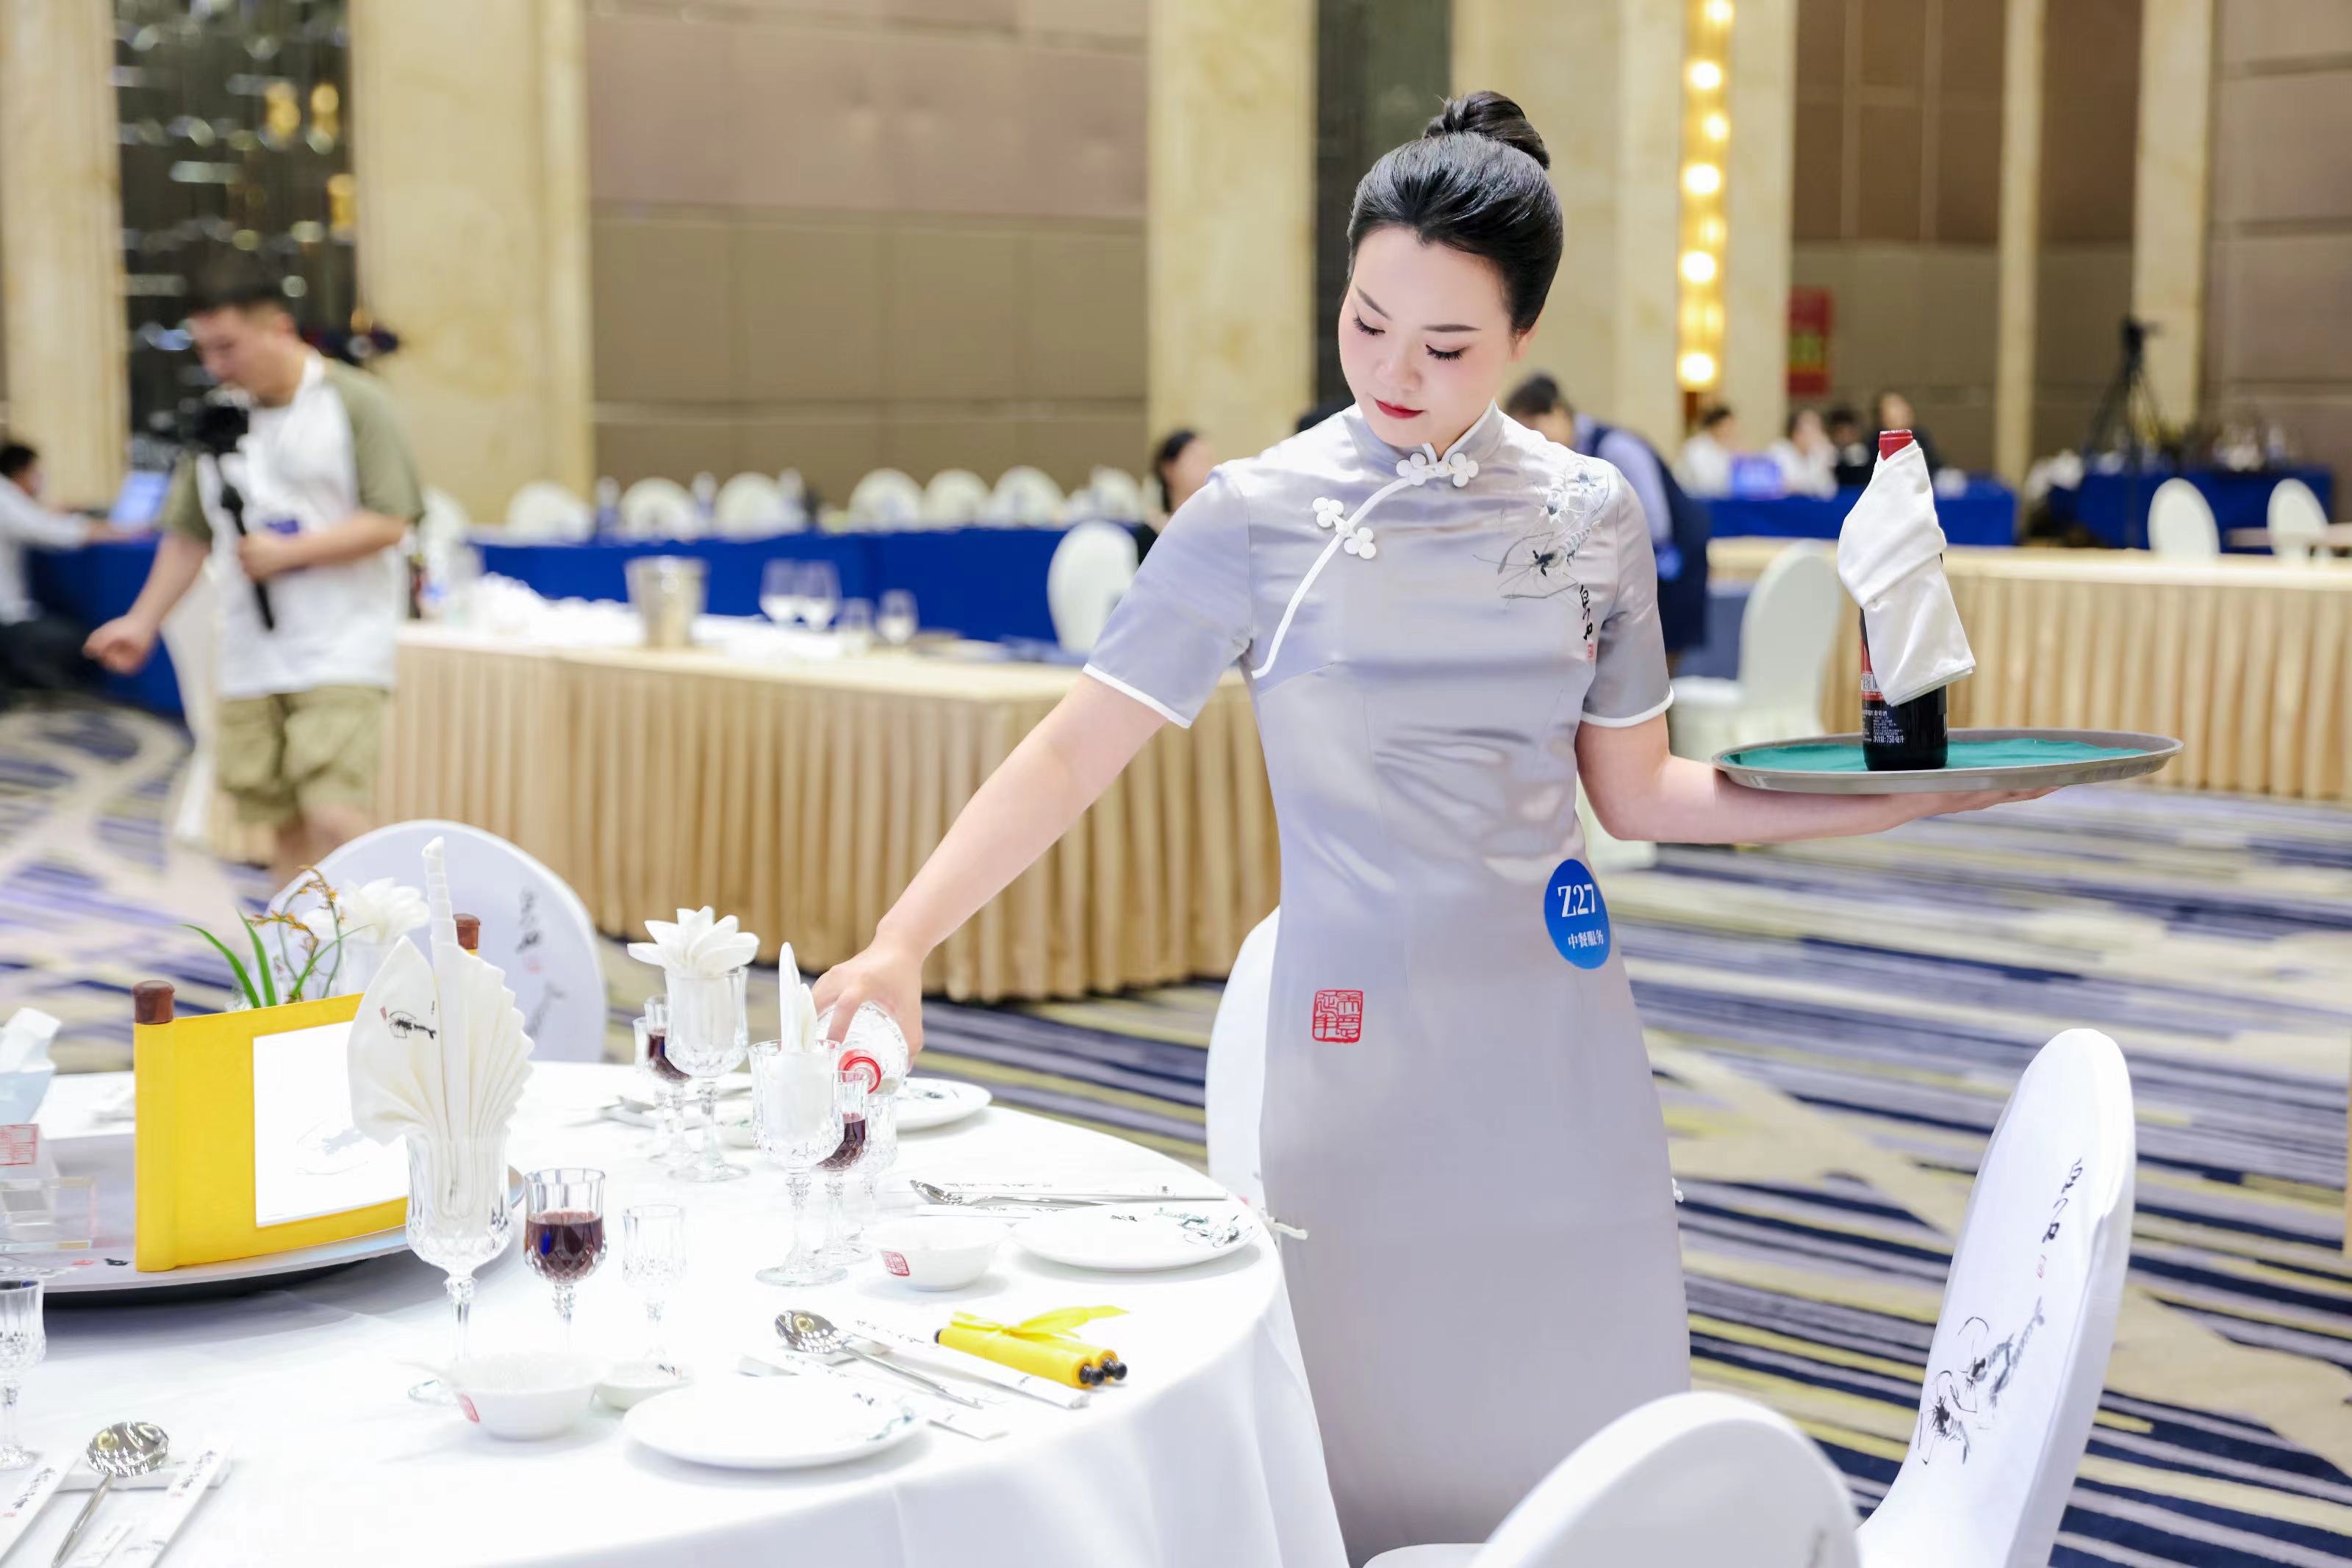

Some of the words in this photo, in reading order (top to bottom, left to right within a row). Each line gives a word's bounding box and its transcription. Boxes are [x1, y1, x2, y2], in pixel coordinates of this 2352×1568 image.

[1557, 883, 1596, 918] Z27
[1568, 929, 1604, 950] 中餐服务
